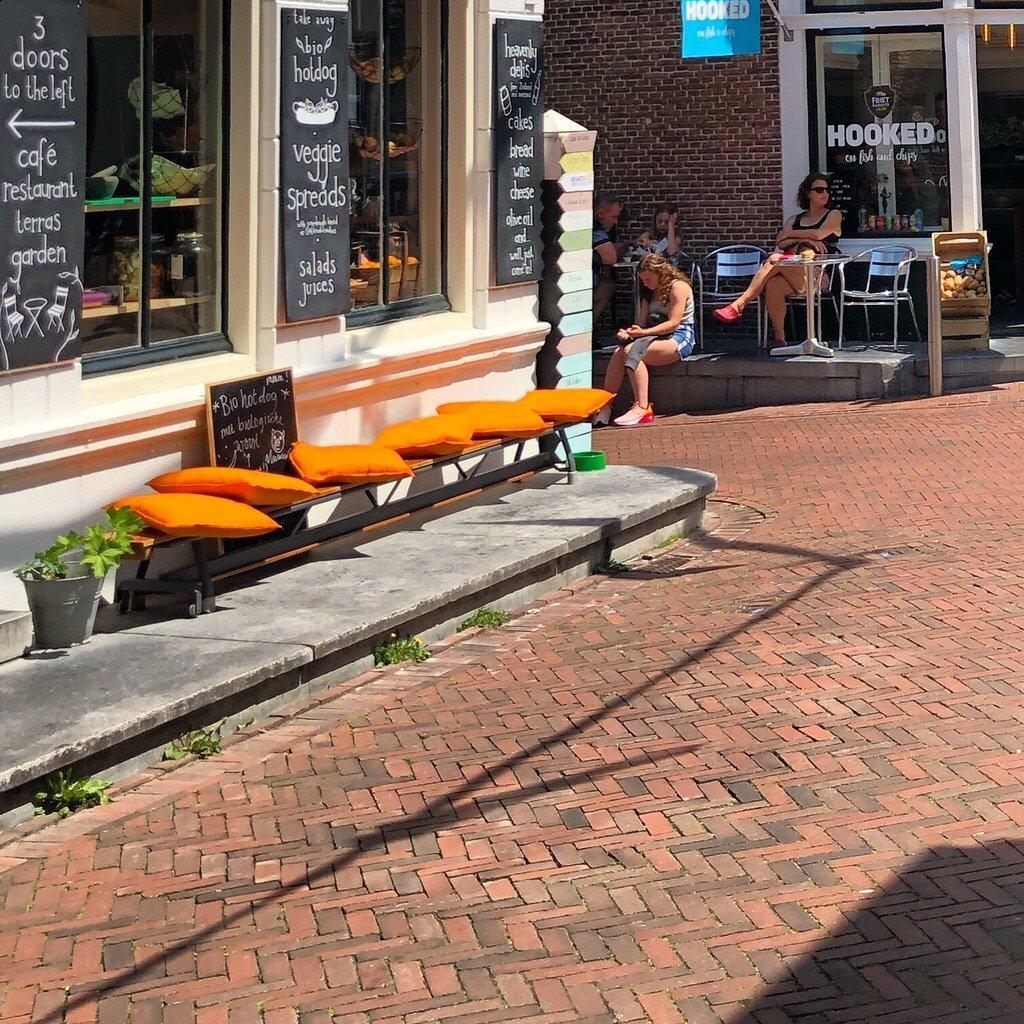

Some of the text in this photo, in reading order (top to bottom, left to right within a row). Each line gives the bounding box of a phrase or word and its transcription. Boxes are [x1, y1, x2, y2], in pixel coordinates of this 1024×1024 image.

[685, 0, 750, 21] HOOKED
[33, 16, 46, 40] 3
[12, 36, 69, 71] doors
[305, 35, 323, 55] bio
[293, 55, 337, 97] hotdog
[4, 73, 76, 108] to the left
[508, 108, 533, 130] cakes
[827, 122, 935, 147] HOOKED
[18, 137, 58, 176] café
[509, 137, 534, 158] bread
[845, 154, 856, 163] on
[859, 148, 874, 164] fish
[877, 148, 894, 161] and
[896, 148, 918, 164] chips
[292, 140, 342, 187] veggie
[513, 162, 530, 177] wine
[4, 172, 78, 203] restaurant
[287, 175, 346, 220] spreads
[510, 179, 535, 200] cheese
[16, 209, 61, 233] terras
[10, 234, 67, 283] garden
[299, 251, 336, 277] salads
[299, 278, 335, 307] juices
[220, 395, 238, 416] Bio
